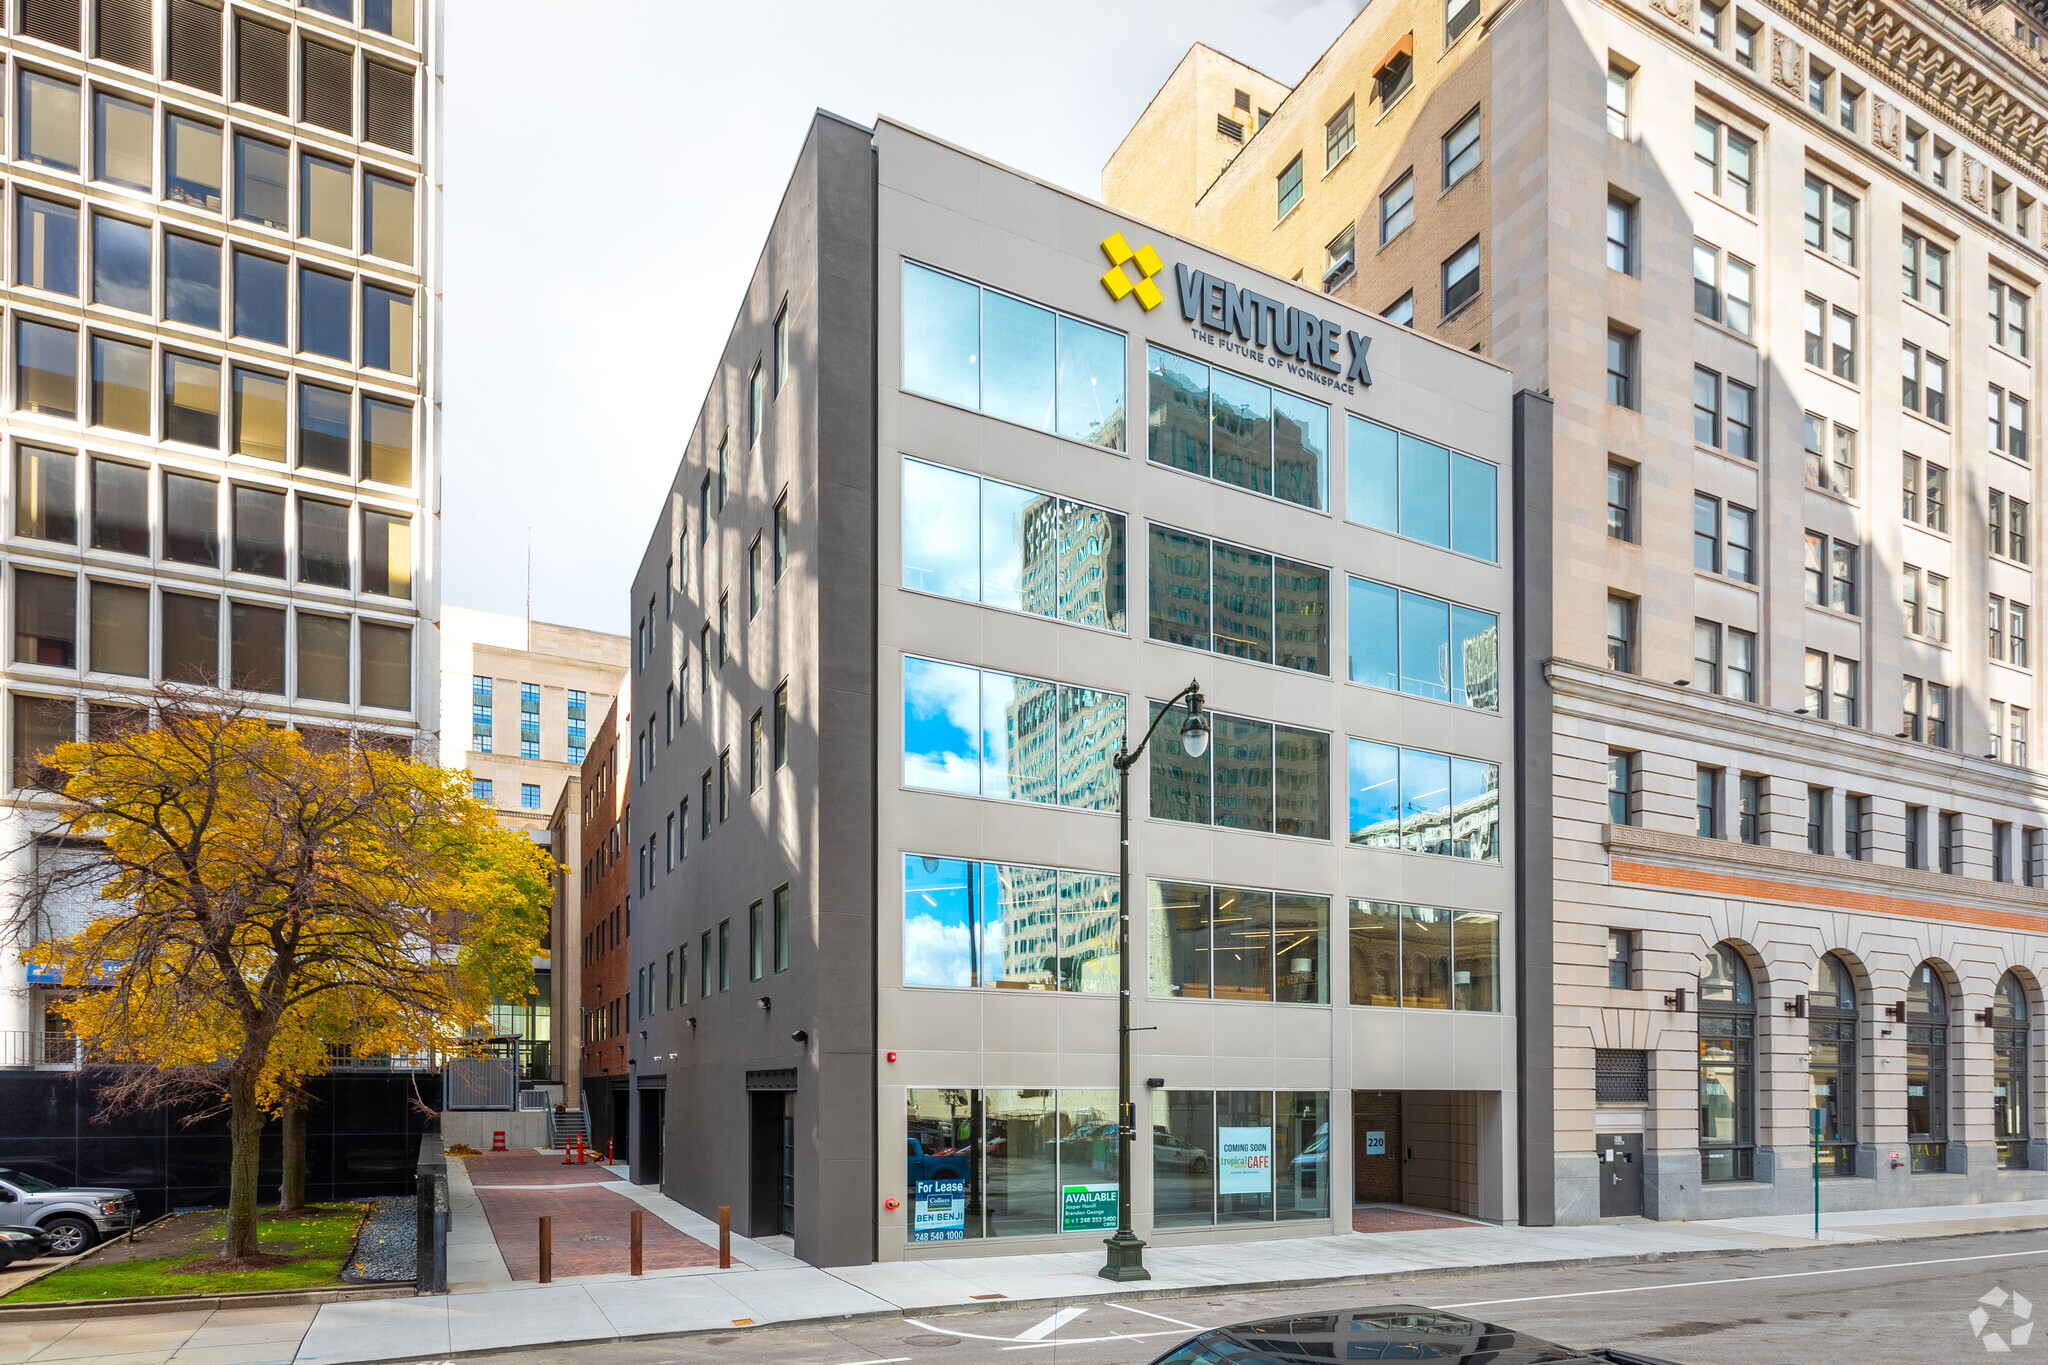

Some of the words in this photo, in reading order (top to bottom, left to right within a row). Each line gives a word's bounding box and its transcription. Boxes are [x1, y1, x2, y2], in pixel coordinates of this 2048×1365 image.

[1175, 262, 1341, 374] VENTURE
[1346, 330, 1372, 386] X
[1191, 327, 1215, 346] THE
[1218, 338, 1264, 364] FUTURE
[1268, 356, 1283, 369] OF
[1287, 363, 1355, 396] WORKSPACE
[1224, 1144, 1249, 1152] COMING
[1368, 1137, 1384, 1147] 220
[1221, 1156, 1247, 1166] tropical
[1247, 1156, 1269, 1168] CAFE
[918, 1181, 933, 1193] For
[935, 1181, 963, 1192] Lease
[1065, 1192, 1116, 1203] AVAILABLE
[916, 1214, 934, 1222] BEN
[915, 1232, 929, 1242] 248
[930, 1231, 944, 1241] 540
[946, 1230, 964, 1240] 1000
